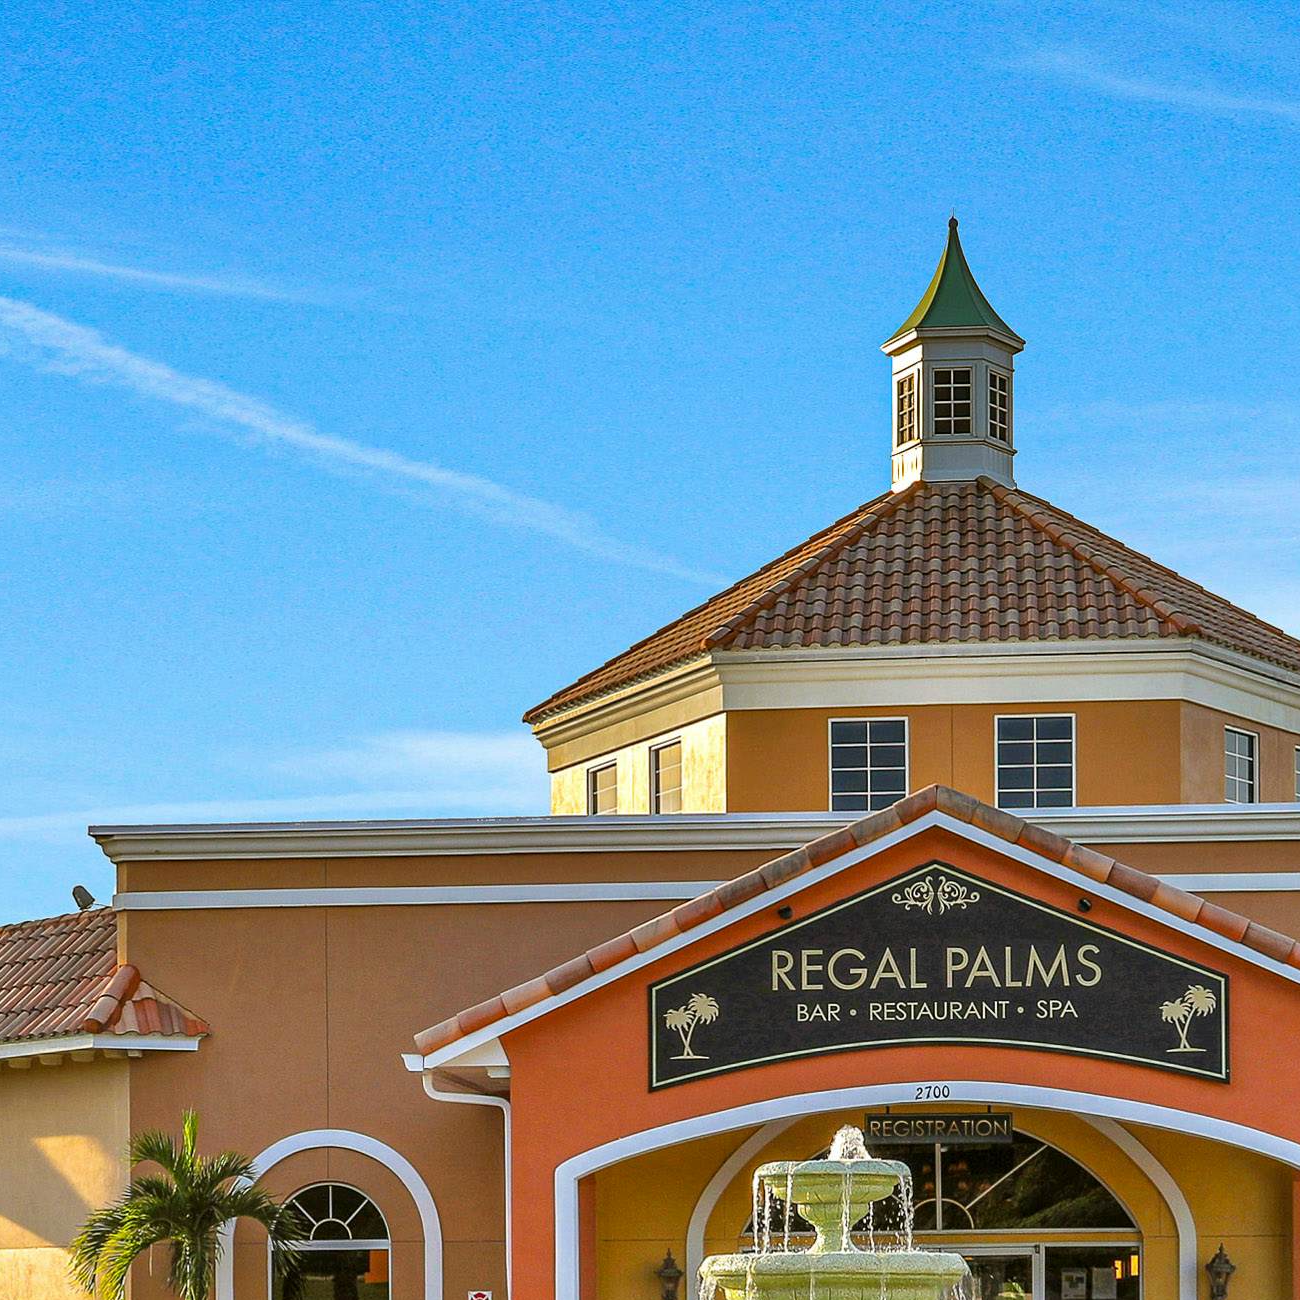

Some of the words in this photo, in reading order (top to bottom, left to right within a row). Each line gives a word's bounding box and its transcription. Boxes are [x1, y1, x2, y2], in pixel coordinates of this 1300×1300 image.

[771, 948, 928, 991] REGAL
[946, 943, 1102, 988] PALMS
[796, 1003, 841, 1022] BAR
[868, 1000, 1010, 1021] RESTAURANT
[1035, 999, 1078, 1019] SPA
[915, 1085, 950, 1100] 2700
[870, 1119, 1007, 1137] REGISTRATION
